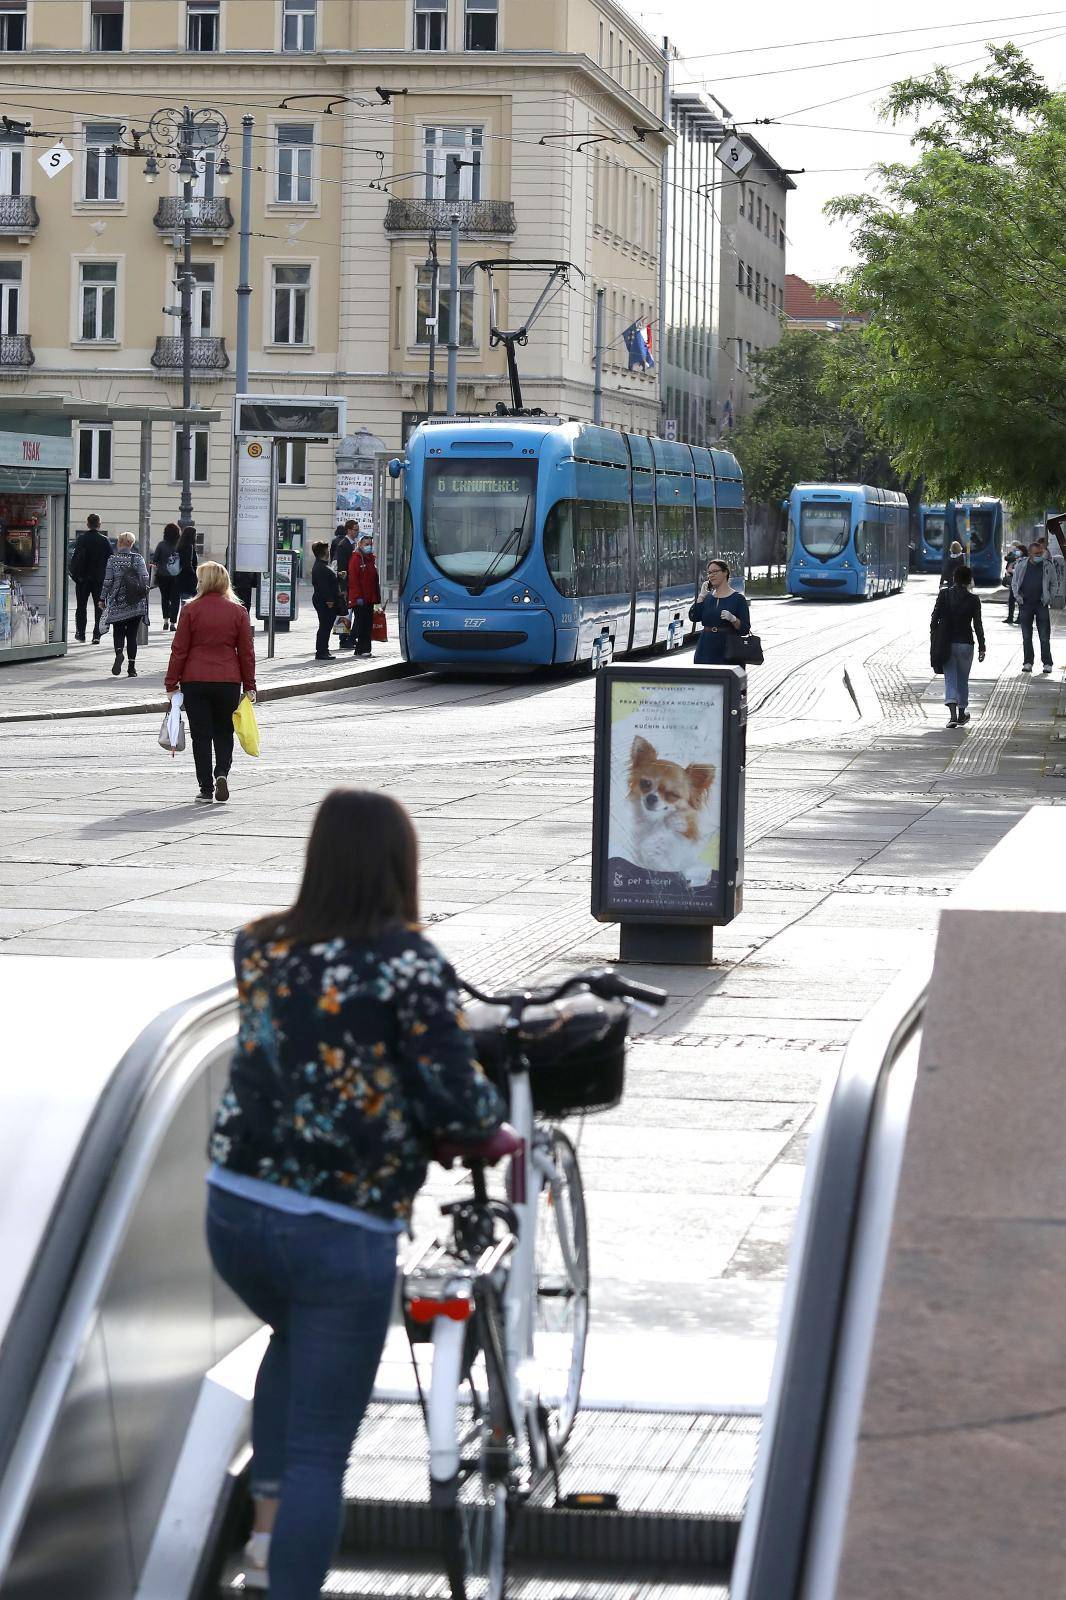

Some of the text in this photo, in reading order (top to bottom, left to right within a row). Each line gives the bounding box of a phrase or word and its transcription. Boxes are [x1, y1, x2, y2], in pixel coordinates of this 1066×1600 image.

[49, 153, 61, 167] S
[22, 441, 41, 461] TISAK
[422, 620, 440, 628] 2213
